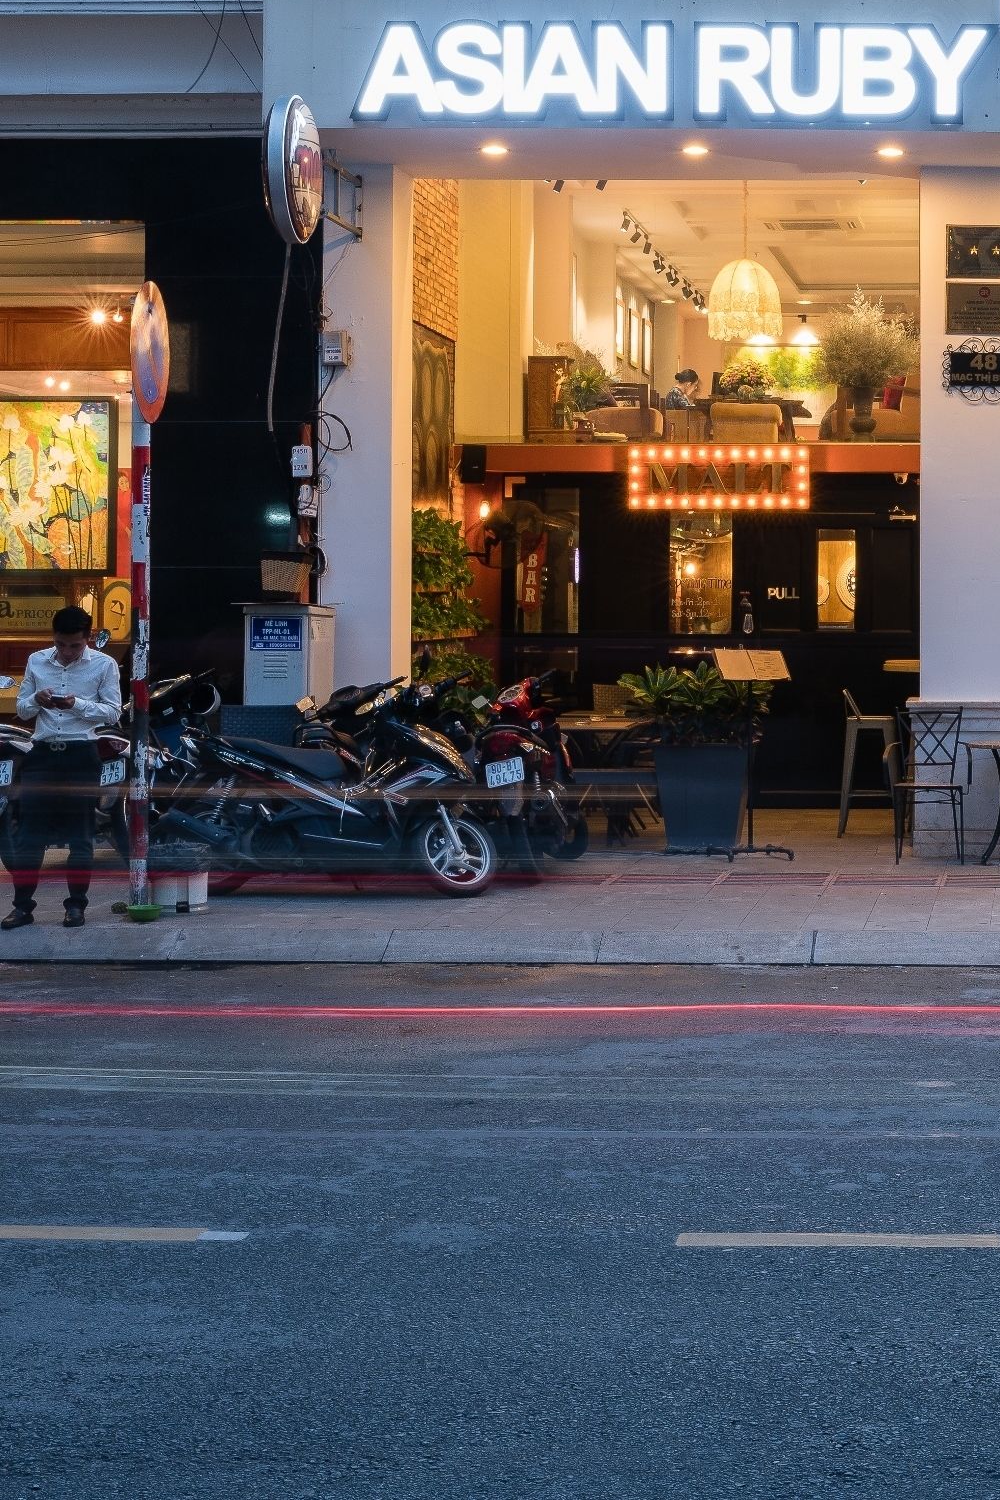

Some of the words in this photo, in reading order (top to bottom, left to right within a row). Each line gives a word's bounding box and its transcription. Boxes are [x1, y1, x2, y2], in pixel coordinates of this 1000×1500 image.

[356, 23, 670, 116] ASIAN
[697, 25, 990, 118] RUBY
[970, 353, 998, 371] 48
[645, 461, 794, 495] MALT
[525, 553, 538, 603] BAR
[767, 587, 800, 600] PULL
